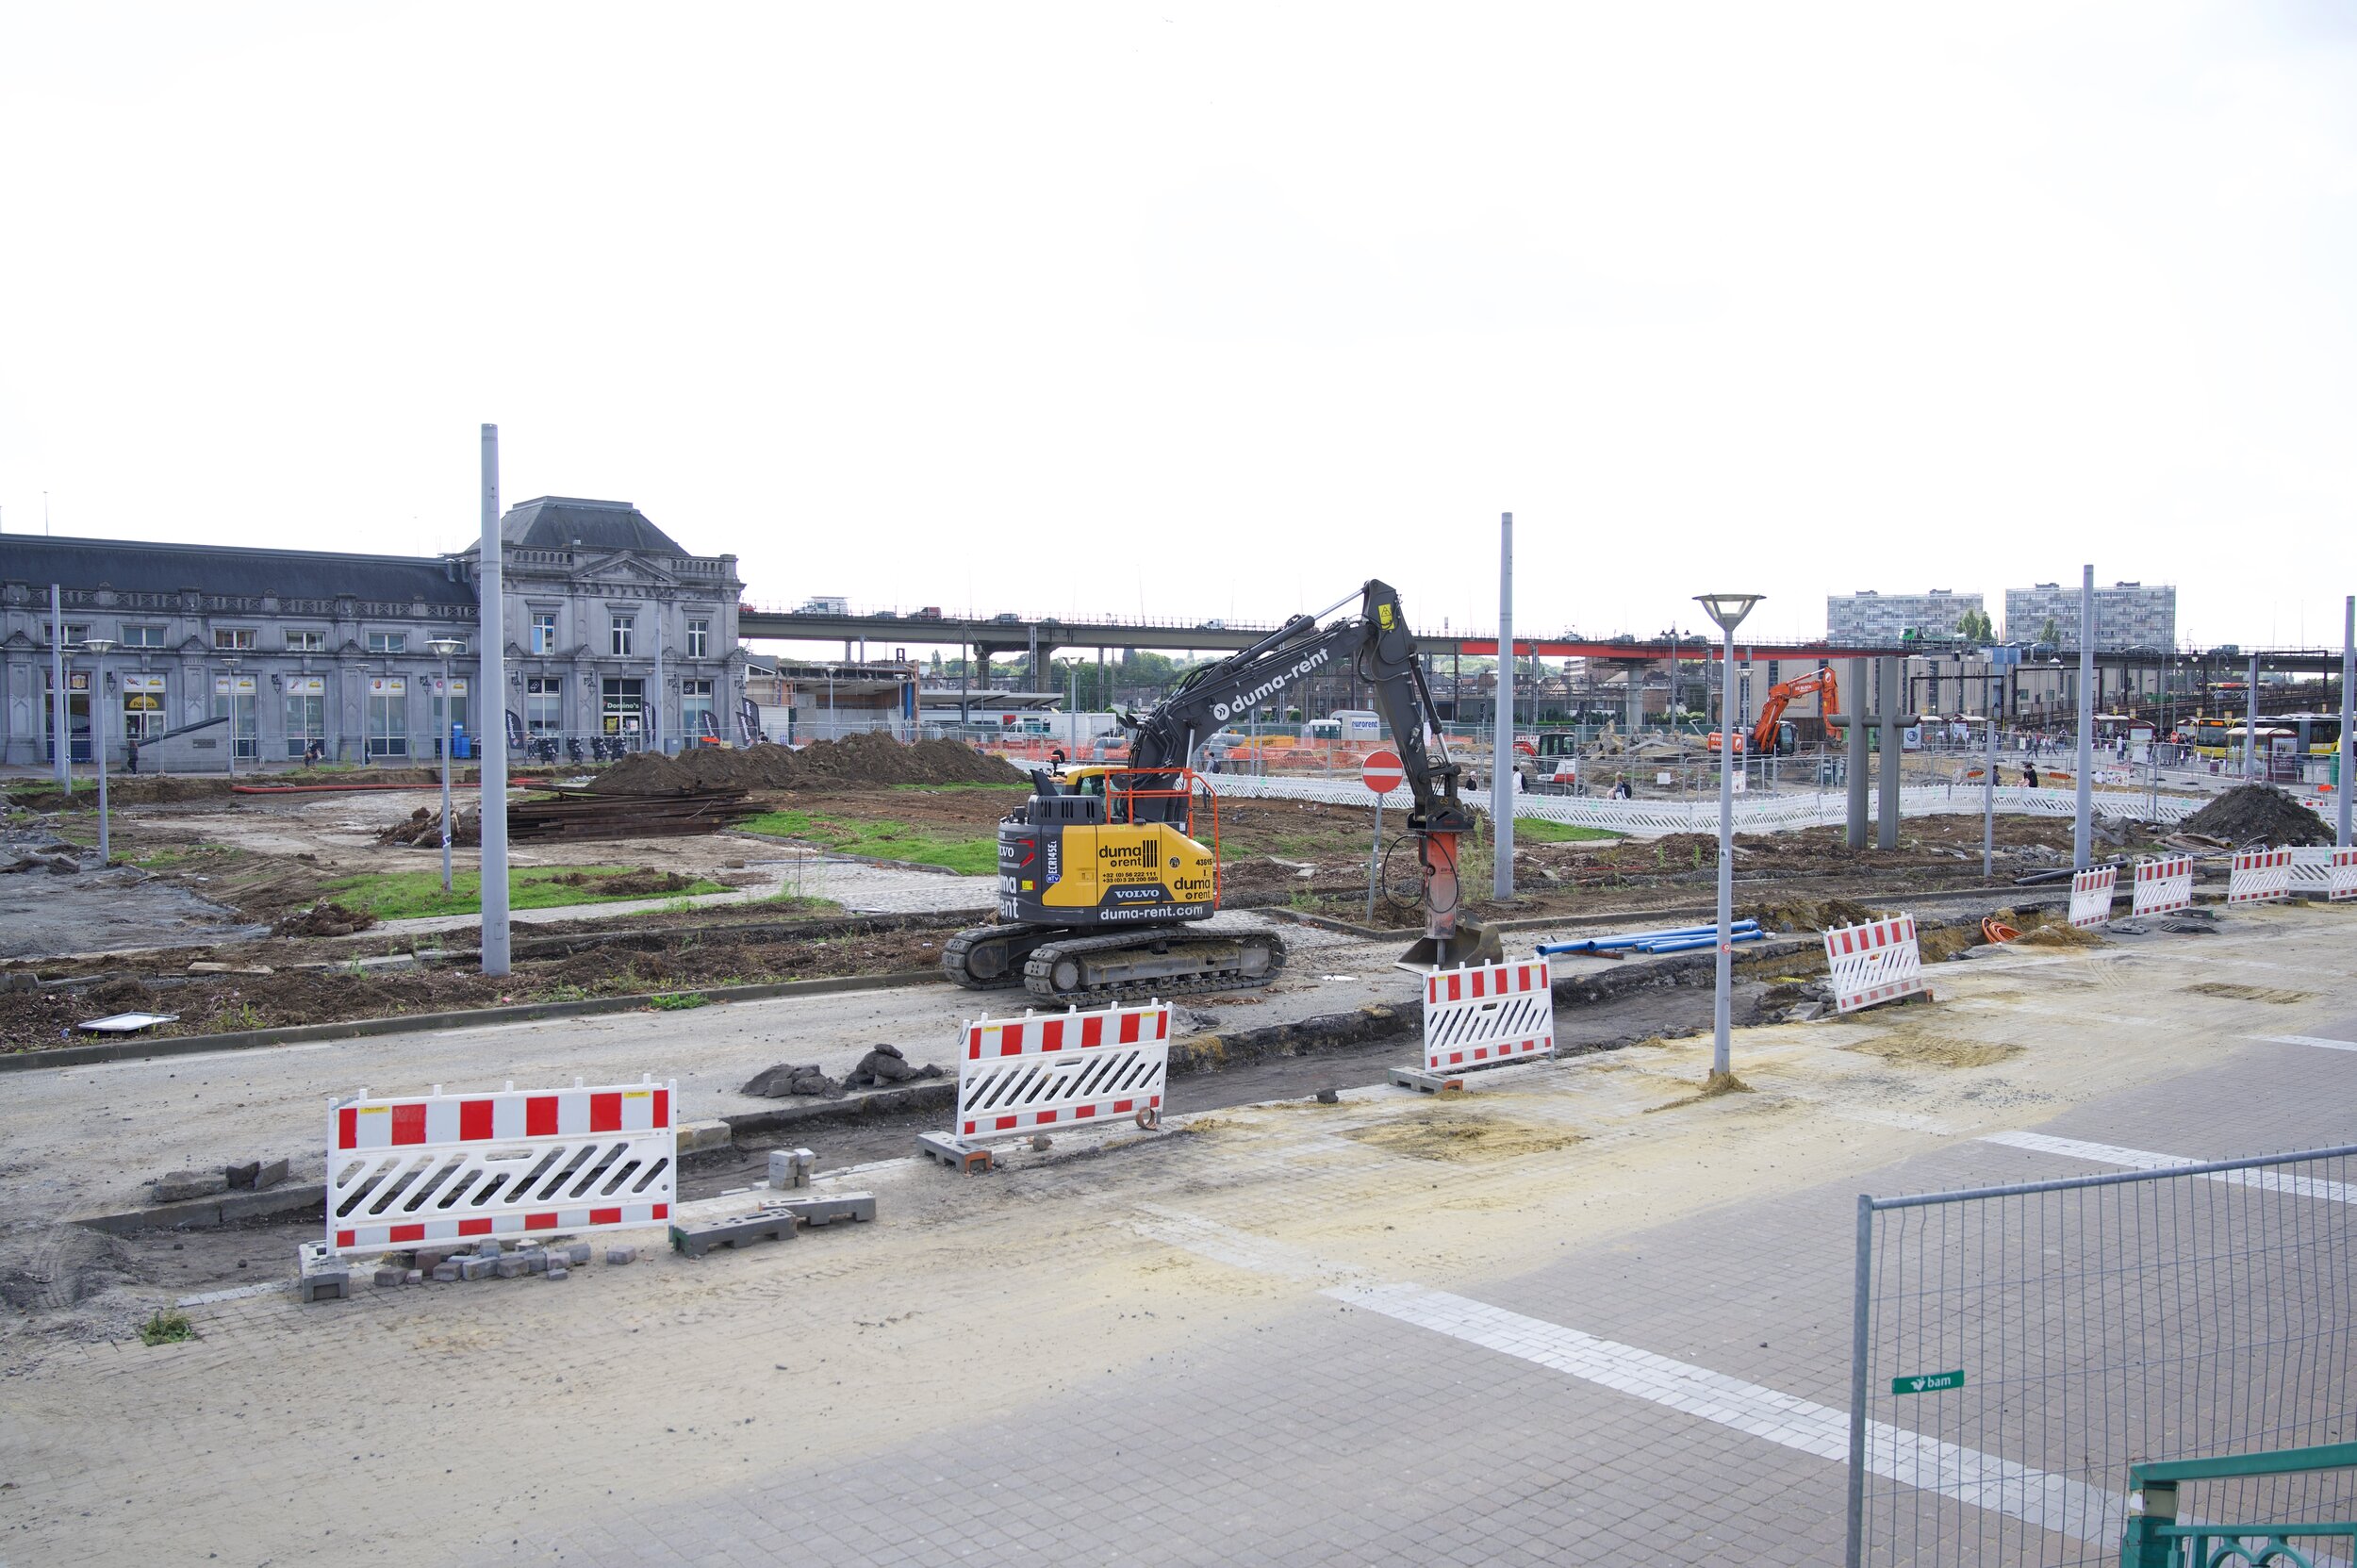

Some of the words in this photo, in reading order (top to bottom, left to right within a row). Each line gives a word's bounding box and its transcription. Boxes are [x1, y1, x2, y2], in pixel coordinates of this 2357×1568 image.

[1231, 648, 1328, 713] duma-rent
[1099, 845, 1142, 858] duma
[1118, 857, 1142, 867] rent
[1174, 877, 1211, 890] duma
[1114, 889, 1160, 898] VOLVO
[1100, 906, 1203, 920] duma-rent.com
[1927, 1377, 1951, 1388] bam
